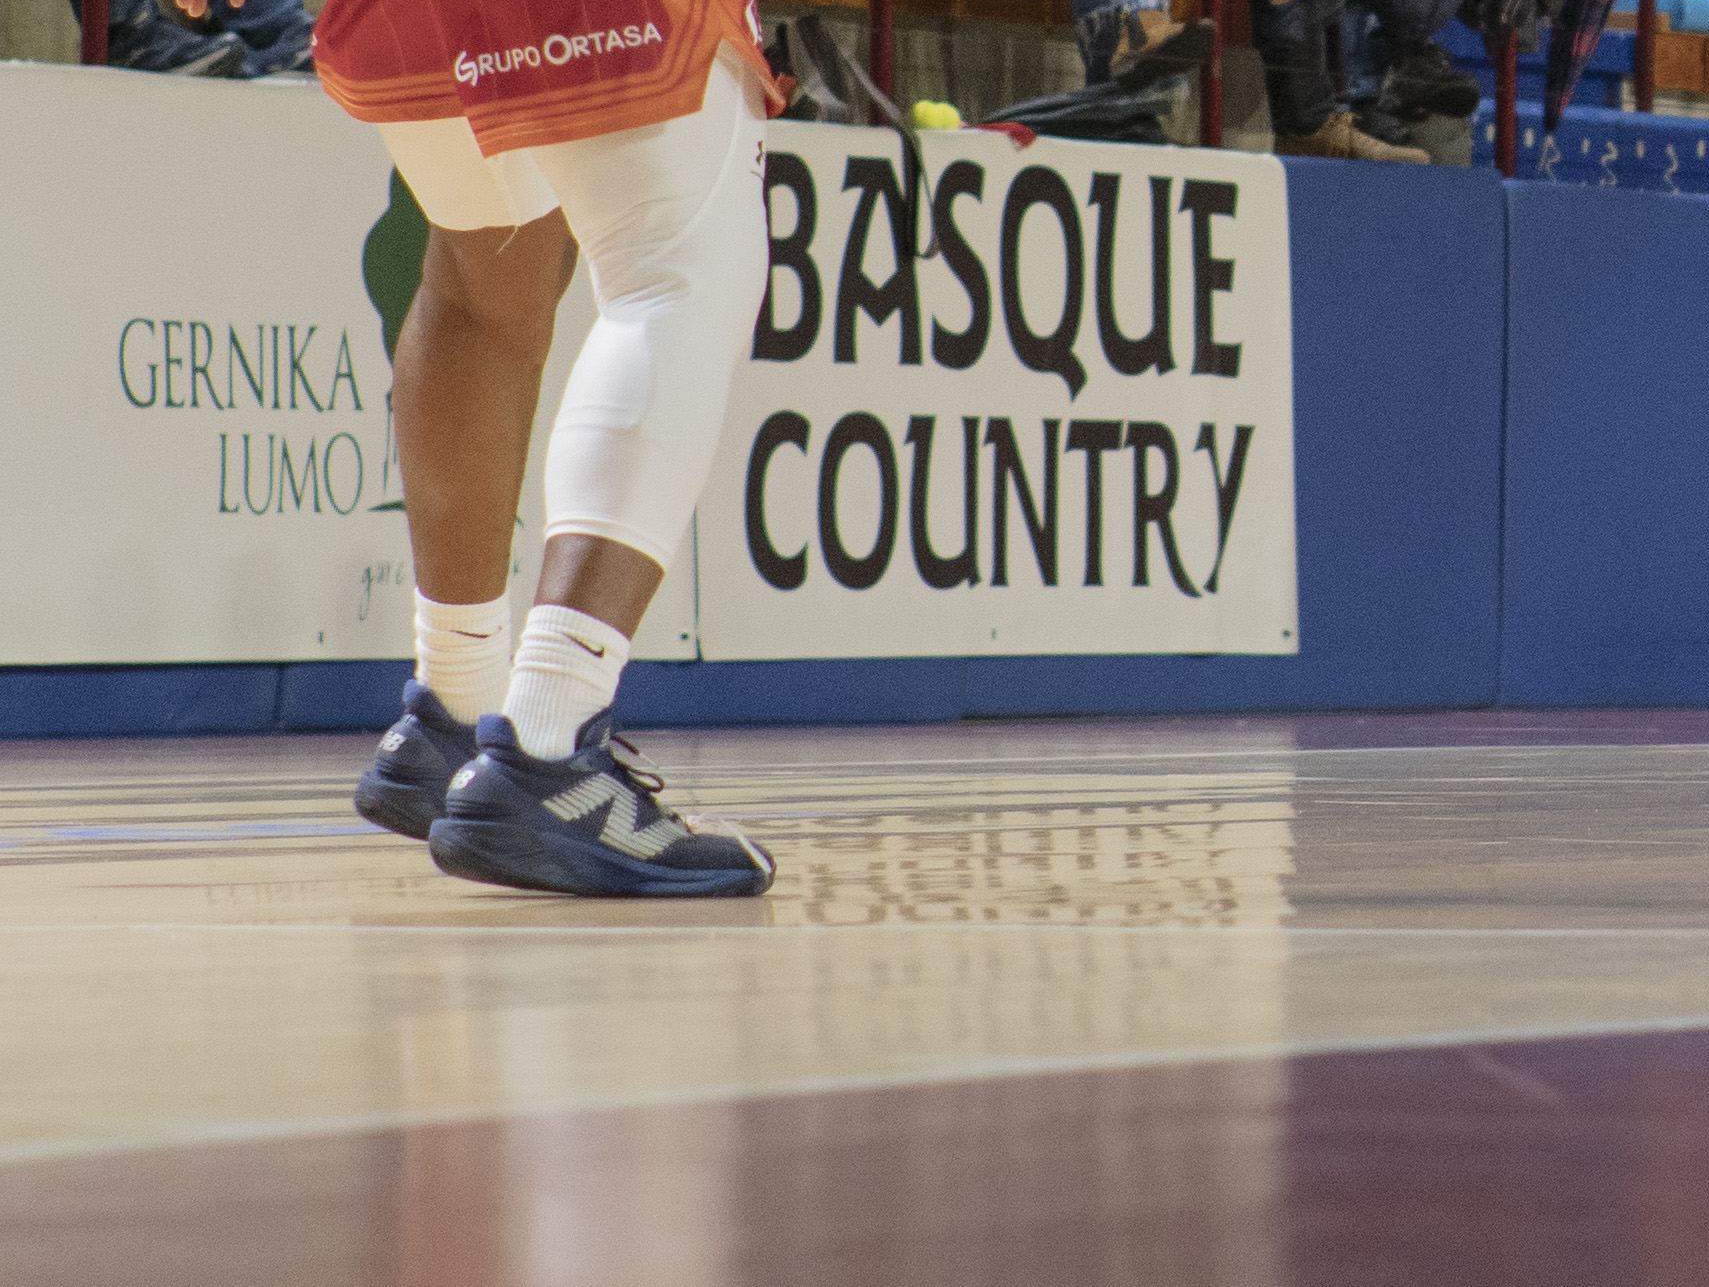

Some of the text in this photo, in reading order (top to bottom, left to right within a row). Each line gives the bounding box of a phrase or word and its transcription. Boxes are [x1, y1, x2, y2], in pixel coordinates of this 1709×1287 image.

[454, 22, 663, 87] GRUPO ORTASA
[751, 150, 1243, 403] BASQUE
[118, 317, 364, 413] GERNIKA
[218, 431, 364, 515] LUMO
[744, 409, 1256, 598] COUNTRY
